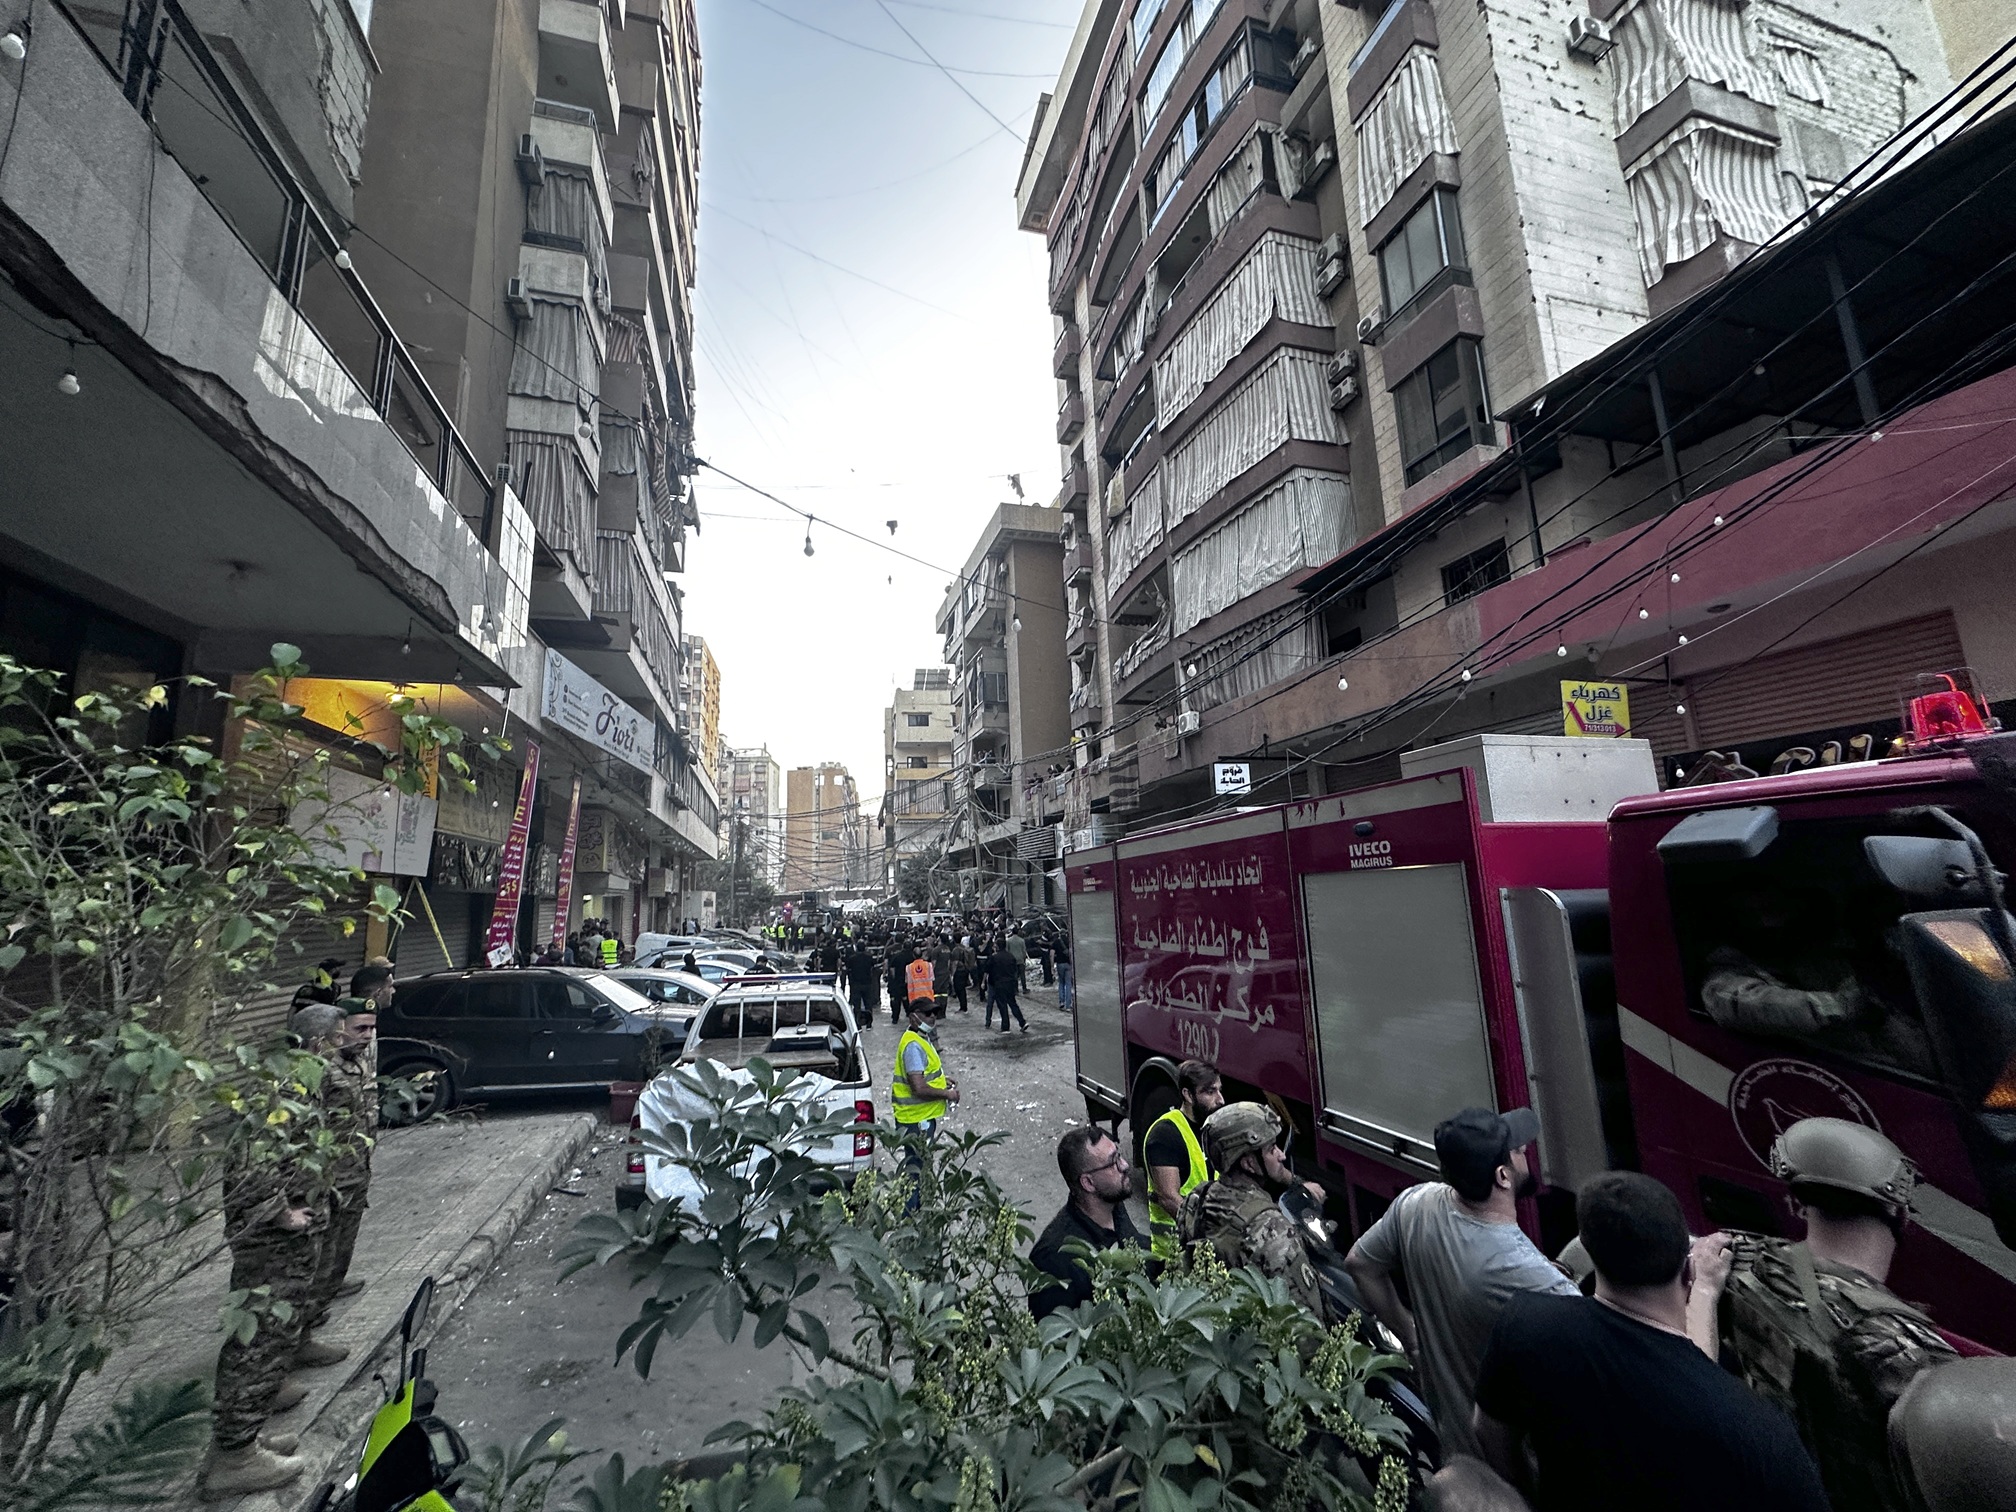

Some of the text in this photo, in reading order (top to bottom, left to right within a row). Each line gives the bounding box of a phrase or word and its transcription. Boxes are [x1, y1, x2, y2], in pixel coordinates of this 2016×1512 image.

[1570, 685, 1621, 702] كهرباء
[1585, 704, 1614, 723] غزل
[1348, 840, 1391, 857] IVECO
[1350, 856, 1393, 869] MAGIRUS
[1129, 854, 1264, 901] إتحاد بلديات الضاحية الجنوبية
[1132, 914, 1185, 959] الضاحية
[1231, 915, 1270, 974] فوج
[1212, 984, 1276, 1033] مركز
[1177, 1018, 1209, 1061] 1290
